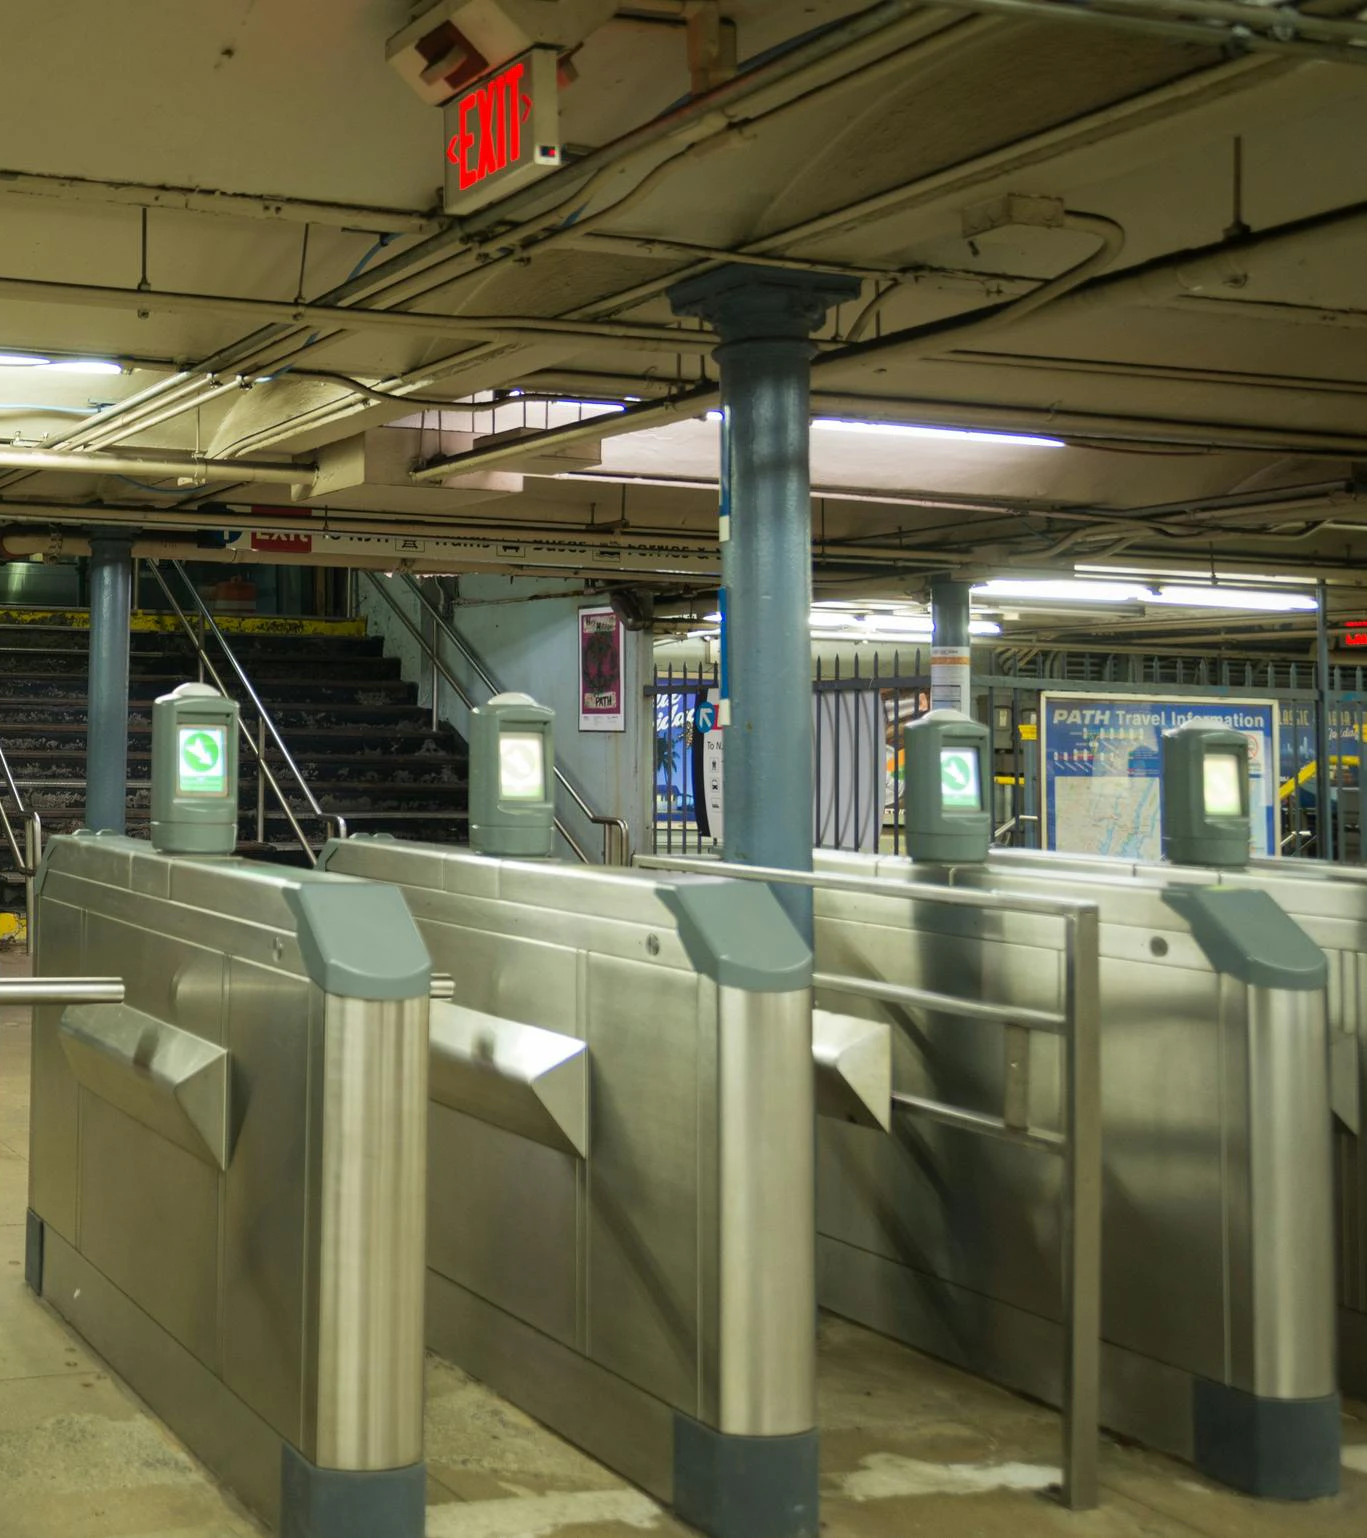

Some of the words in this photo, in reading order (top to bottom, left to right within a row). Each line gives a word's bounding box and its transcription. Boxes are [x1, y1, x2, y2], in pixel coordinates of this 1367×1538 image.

[459, 62, 524, 191] EXIT
[1052, 709, 1111, 725] PATH
[1116, 710, 1166, 727] Travel
[1172, 711, 1265, 728] Infation
[707, 740, 715, 750] To
